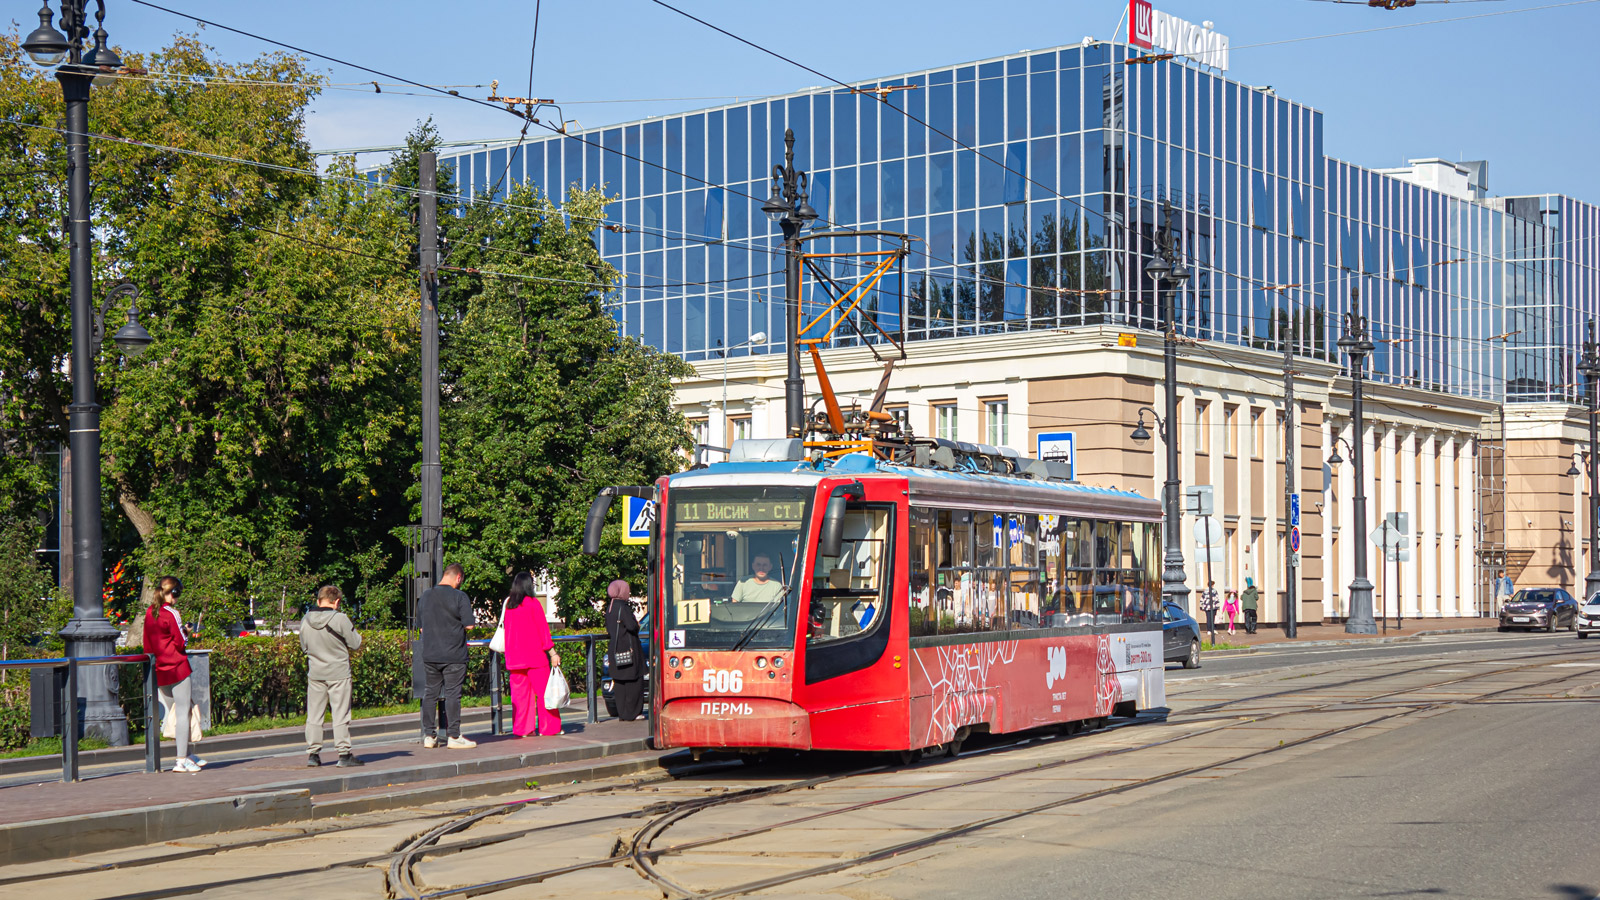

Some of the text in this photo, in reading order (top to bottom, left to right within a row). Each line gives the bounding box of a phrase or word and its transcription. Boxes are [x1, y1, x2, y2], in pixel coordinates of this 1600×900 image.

[1152, 9, 1229, 71] ЛУКОЙЛ
[683, 503, 700, 520] 11
[707, 503, 749, 520] Висим
[683, 602, 701, 623] 11
[702, 669, 743, 693] 506
[700, 702, 753, 715] ПЕРМЬ
